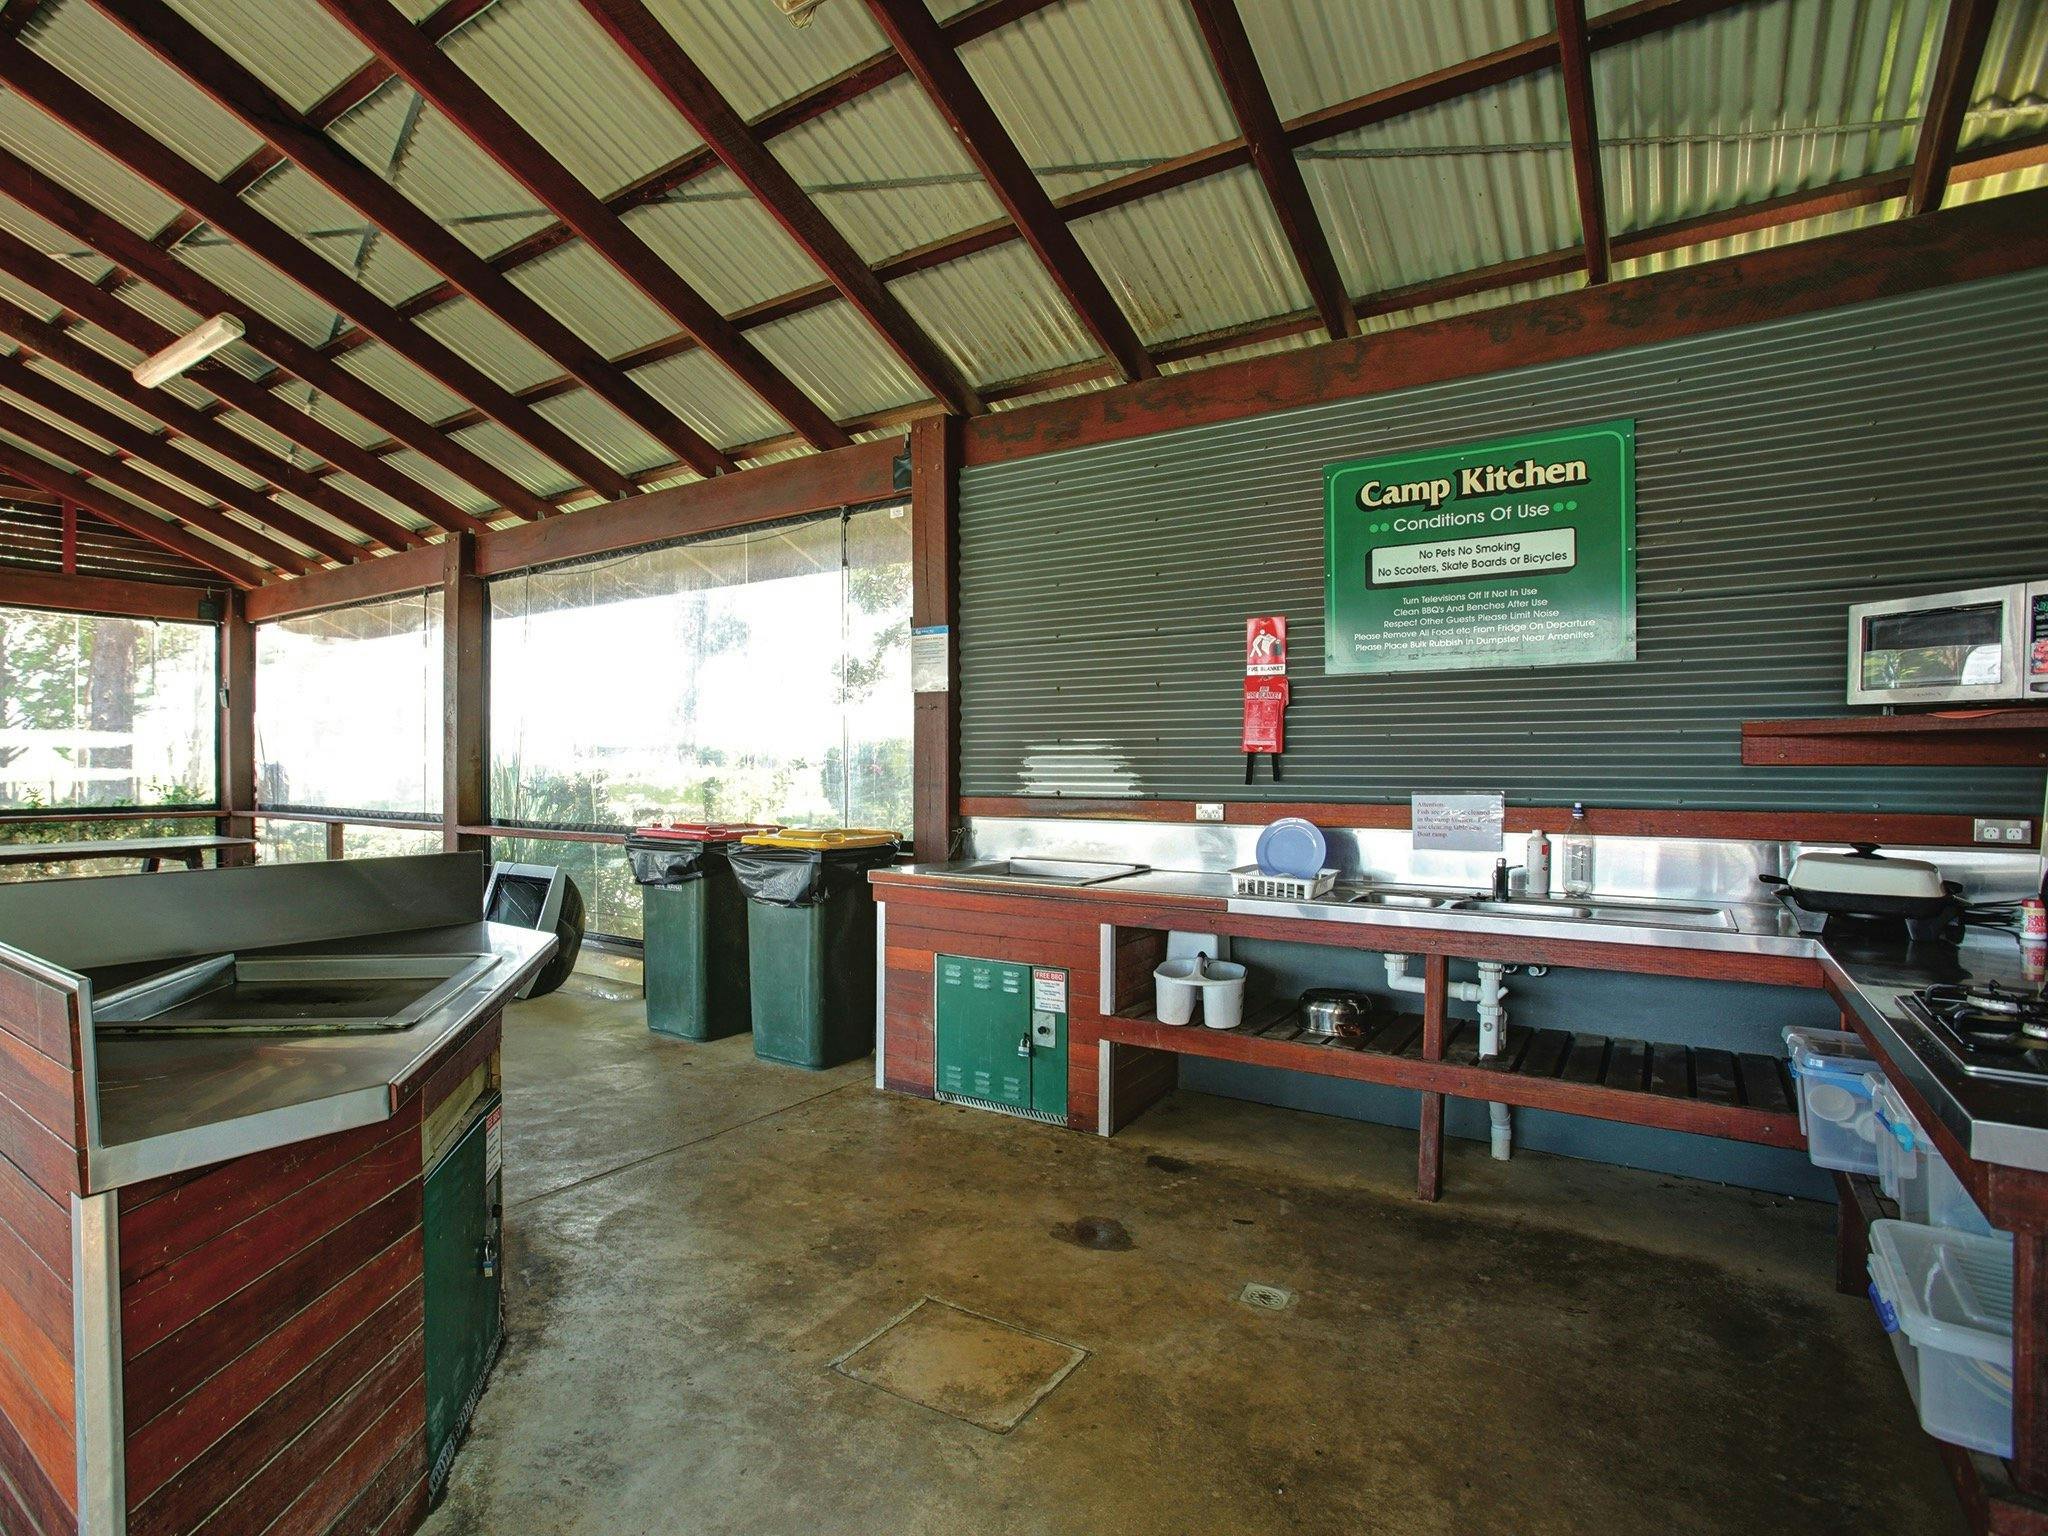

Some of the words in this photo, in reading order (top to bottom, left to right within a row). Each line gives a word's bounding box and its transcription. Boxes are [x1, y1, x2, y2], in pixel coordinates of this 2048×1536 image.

[1360, 477, 1451, 507] Camp
[1461, 458, 1588, 496] Kitchen
[1393, 510, 1485, 533] Conditions
[1490, 507, 1512, 522] Of
[1518, 502, 1550, 519] Use
[1419, 549, 1433, 560] No
[1435, 546, 1457, 559] Pets
[1458, 544, 1473, 555] No
[1475, 541, 1521, 555] Smoking
[1377, 567, 1392, 577] No
[1394, 562, 1439, 577] Scooters,
[1441, 558, 1470, 572] Skate
[1472, 556, 1508, 570] Boards
[1510, 556, 1521, 566] or
[1523, 550, 1568, 565] Bicycles
[1402, 596, 1420, 605] Turn
[1421, 593, 1466, 604] Televisions
[1468, 591, 1482, 599] Off
[1483, 590, 1490, 599] If
[1492, 589, 1508, 598] Not
[1510, 589, 1519, 597] In
[1521, 587, 1538, 596] Use
[1393, 607, 1420, 617] Clean
[1421, 605, 1445, 615] BBQ's
[1446, 604, 1465, 613] And
[1466, 601, 1505, 612] Benches
[1507, 600, 1529, 609] After
[1531, 598, 1548, 607] Use
[1383, 618, 1418, 629] Respect
[1420, 617, 1444, 626] Other
[1446, 614, 1476, 625] Guests
[1477, 612, 1508, 622] Please
[1510, 610, 1531, 620] Limit
[1533, 608, 1560, 618] Noise
[1354, 631, 1381, 641] Please
[1383, 629, 1417, 639] Remove
[1419, 627, 1430, 637] All
[1431, 626, 1454, 635] Food
[1456, 625, 1471, 634] etc
[1473, 623, 1495, 633] From
[1497, 622, 1527, 633] Fridge
[1528, 620, 1544, 630] On
[1546, 618, 1596, 630] Departure
[1355, 642, 1382, 652] Please
[1384, 640, 1408, 649] Place
[1410, 638, 1427, 648] Bulk
[1429, 636, 1463, 647] Rubbish
[1465, 636, 1474, 645] In
[1476, 633, 1520, 646] Dumpster
[1522, 632, 1546, 642] Near
[1548, 630, 1595, 639] Amenities
[1050, 973, 1063, 981] BBQ
